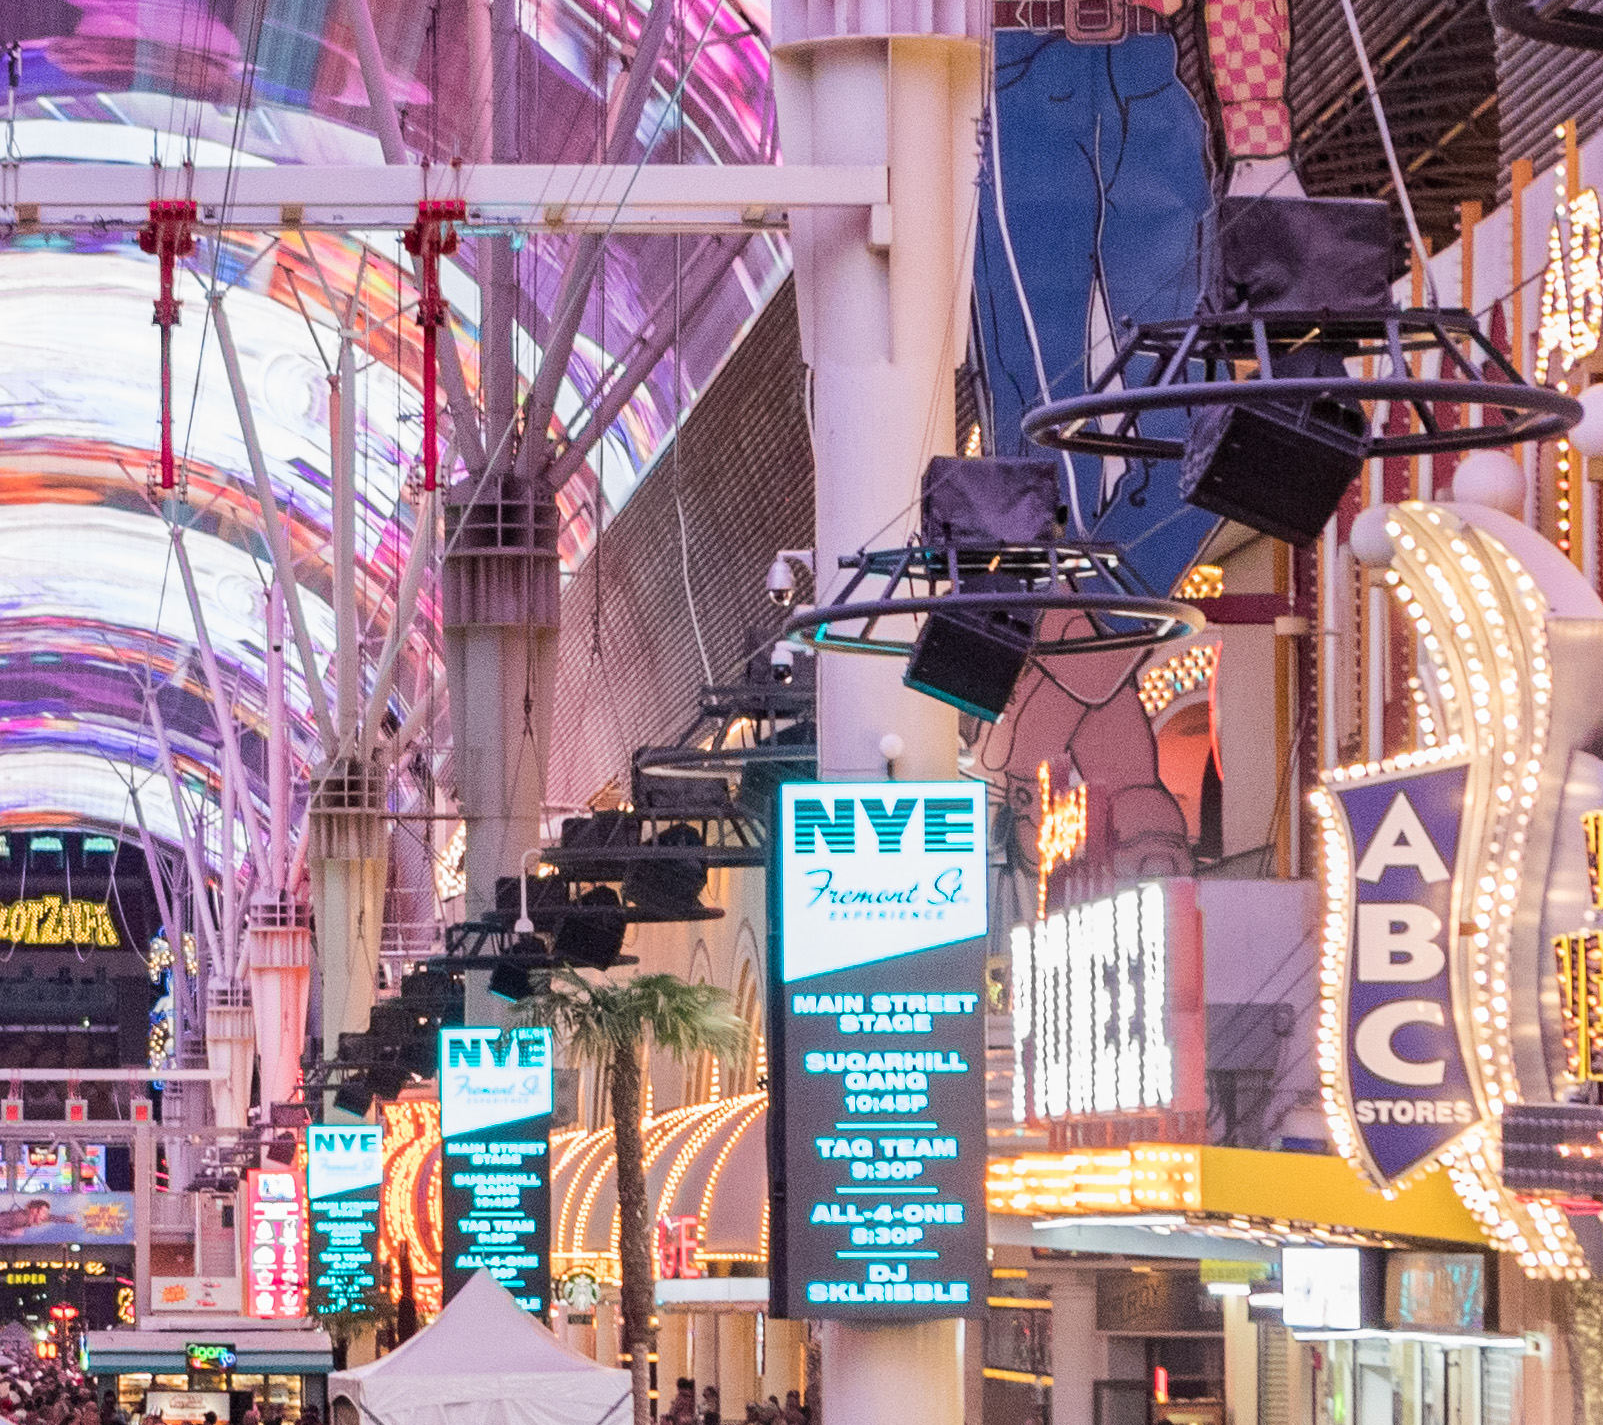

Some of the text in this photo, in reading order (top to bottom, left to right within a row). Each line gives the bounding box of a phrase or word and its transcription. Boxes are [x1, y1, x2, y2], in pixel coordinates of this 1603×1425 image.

[794, 798, 974, 854] NYE
[805, 867, 969, 908] Fremont St.
[829, 910, 946, 921] EXPERIENCE
[1356, 790, 1451, 1086] ABC
[792, 994, 979, 1015] MAIN STREET
[837, 1013, 933, 1033] STAGE
[448, 1036, 545, 1069] NYE
[805, 1052, 968, 1074] SUGARHILL
[844, 1072, 928, 1092] GANG
[844, 1094, 928, 1114] 10:45P
[1358, 1099, 1472, 1125] STORES
[315, 1133, 376, 1152] NYE
[815, 1138, 957, 1159] TAG TEAM
[851, 1160, 923, 1180] 9:30P
[810, 1203, 965, 1225] ALL-4-ONE
[867, 1264, 910, 1284] DJ
[807, 1283, 970, 1303] SKLRIBBLE
